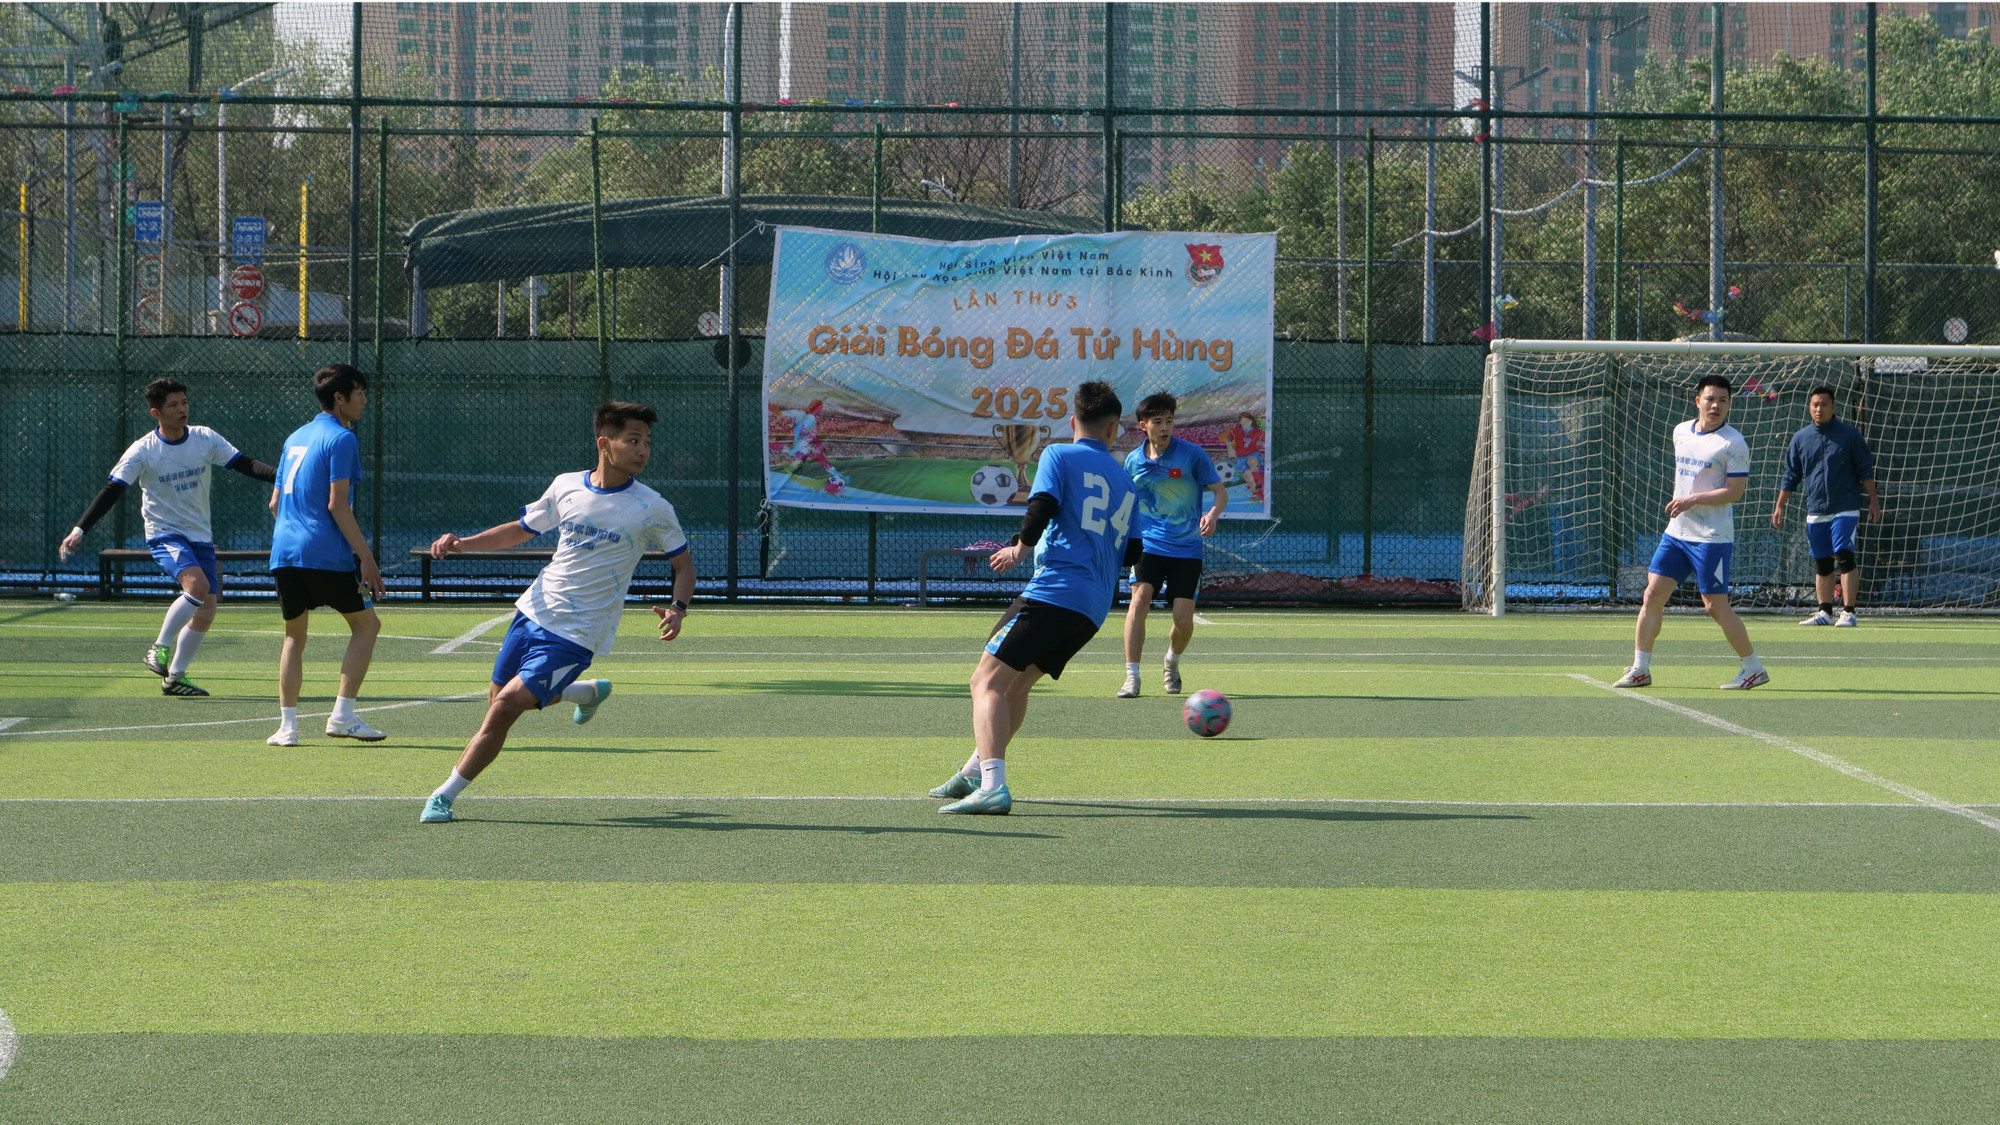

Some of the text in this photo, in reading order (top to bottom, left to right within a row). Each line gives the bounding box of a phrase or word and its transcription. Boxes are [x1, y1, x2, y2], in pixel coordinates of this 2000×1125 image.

[873, 270, 897, 283] Hội
[1004, 266, 1034, 278] Việt
[1041, 266, 1072, 276] Nam
[1080, 266, 1099, 278] tại
[1107, 264, 1132, 276] Bắc
[1140, 267, 1173, 278] Kinh
[965, 259, 996, 269] Sinh
[1042, 251, 1072, 262] Việt
[1079, 251, 1109, 261] Nam
[953, 288, 997, 311] LẦN
[808, 324, 1233, 372] Giải Bóng Đá Tứ Hùng
[970, 386, 1068, 420] 2025
[1243, 437, 1252, 448] 7
[283, 445, 309, 495] 7
[1081, 471, 1136, 550] 24
